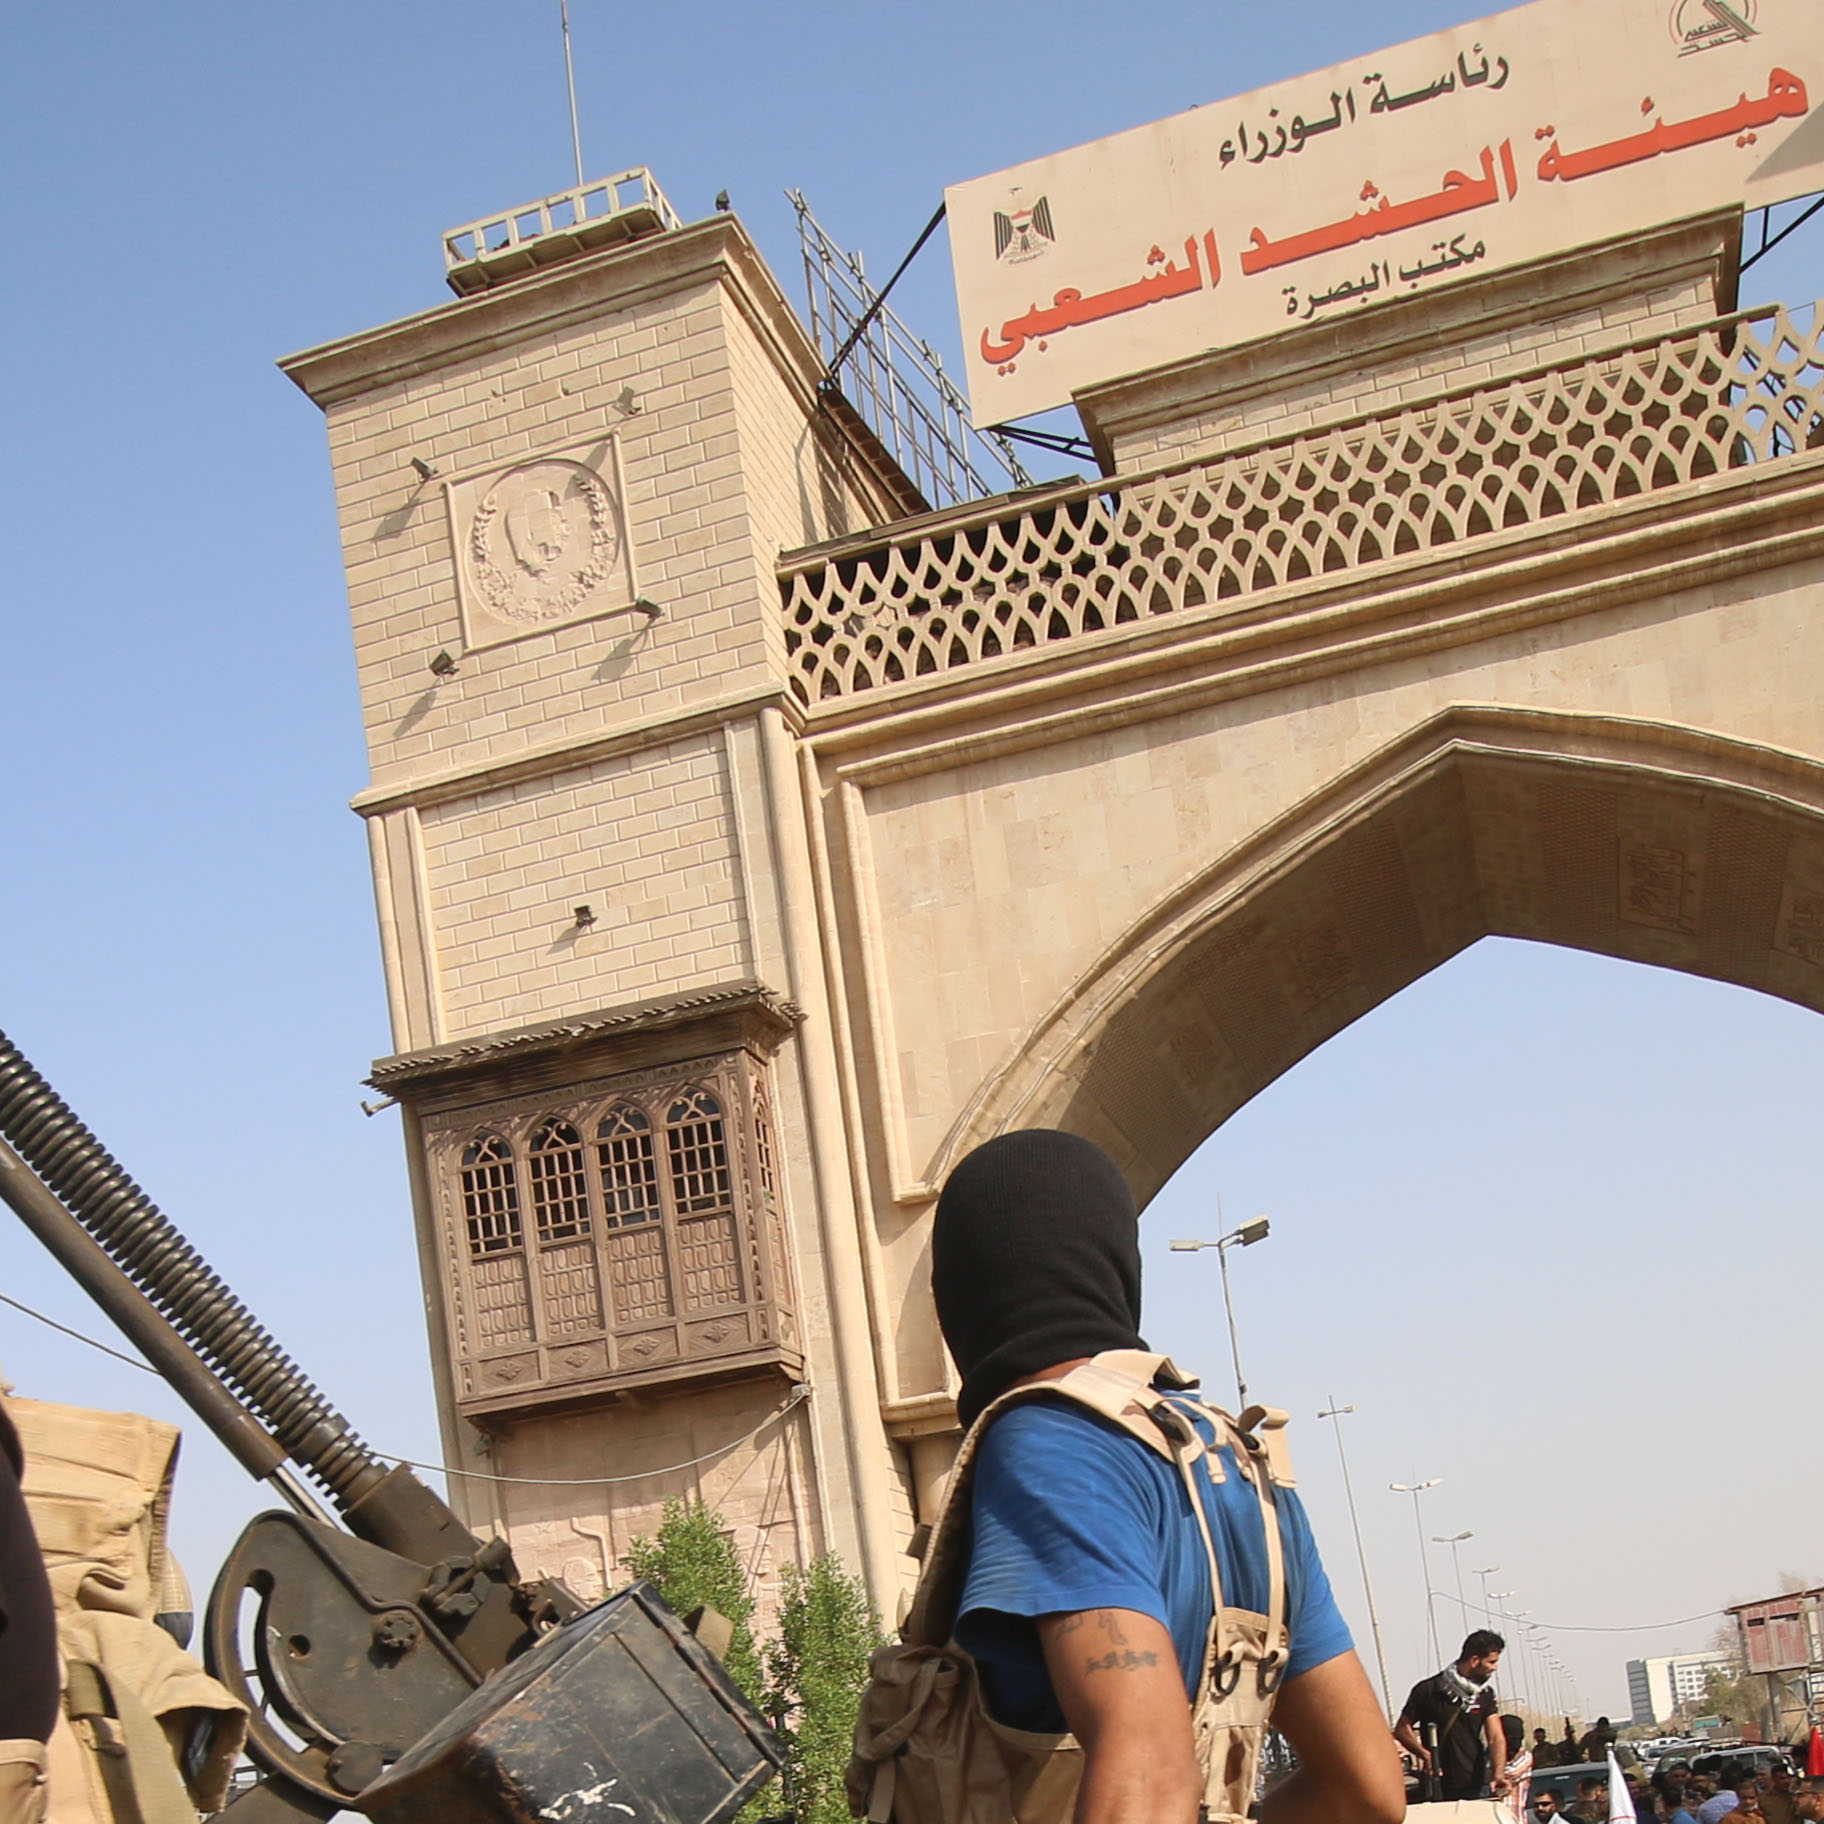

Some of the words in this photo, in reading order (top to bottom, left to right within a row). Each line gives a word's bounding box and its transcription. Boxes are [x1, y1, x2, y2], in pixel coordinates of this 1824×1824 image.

[1363, 43, 1510, 113] رئاسة
[1218, 87, 1356, 170] الوزراء
[1535, 66, 1810, 182] هيئة
[1240, 138, 1519, 277] الحشد
[980, 228, 1222, 375] الشعبي
[1281, 258, 1391, 320] البصرة
[1399, 233, 1486, 289] مكتب
